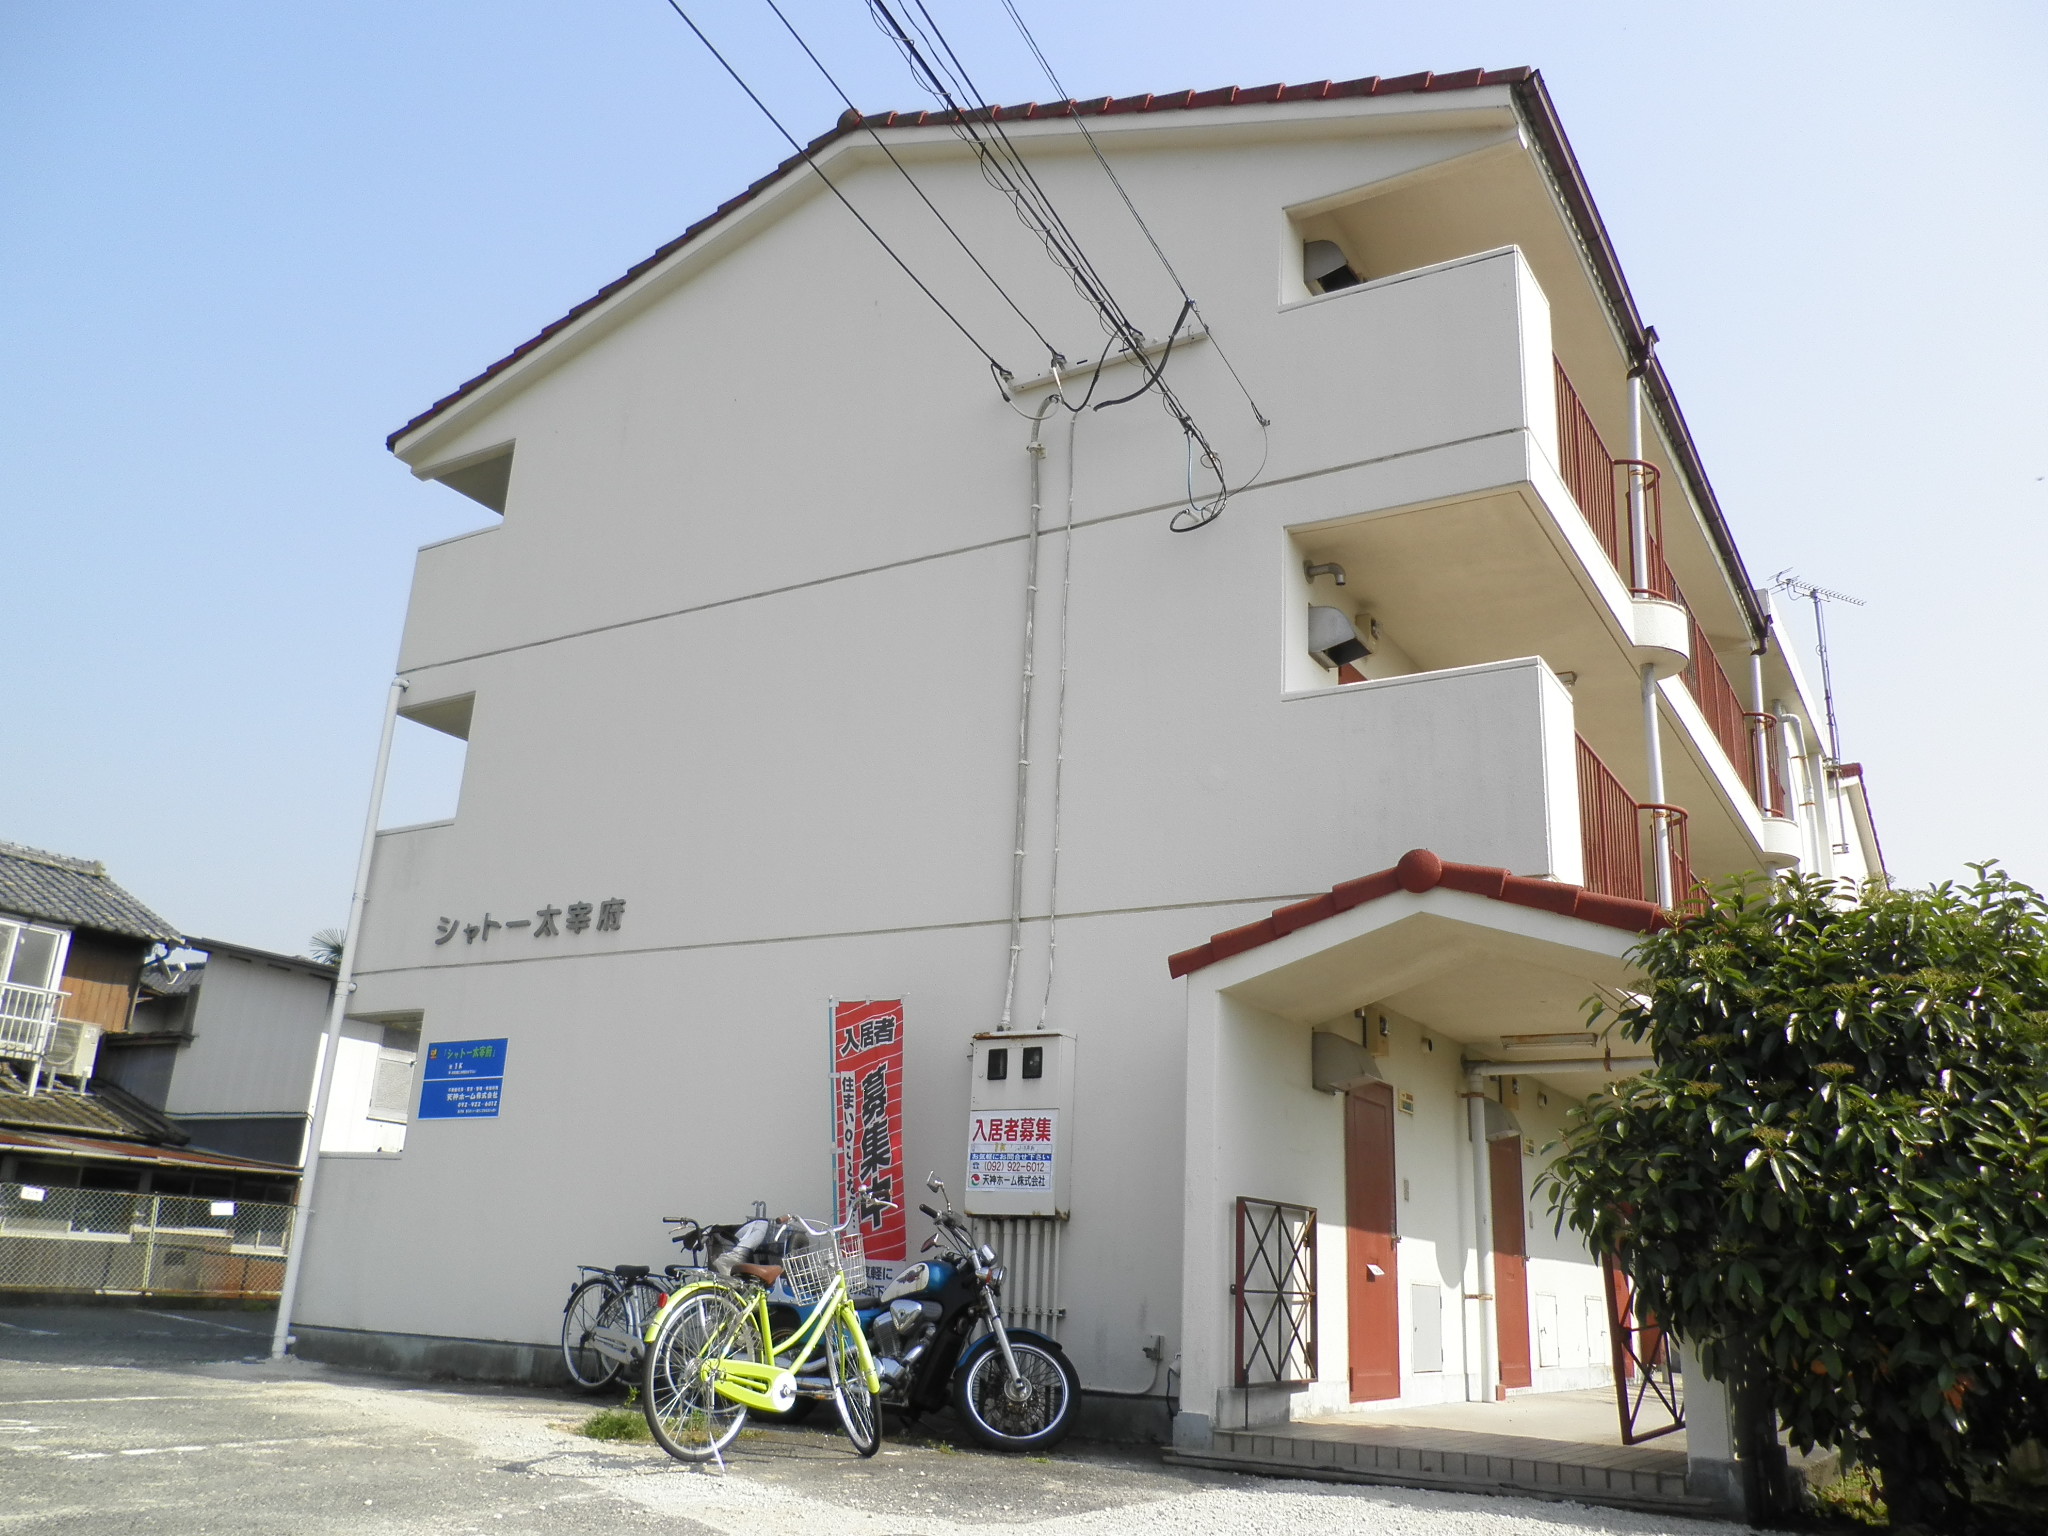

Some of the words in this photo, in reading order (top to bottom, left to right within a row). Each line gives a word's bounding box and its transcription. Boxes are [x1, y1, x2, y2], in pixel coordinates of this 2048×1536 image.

[434, 897, 626, 945] シャトー太宰府
[840, 1015, 896, 1057] 入居者
[860, 1061, 892, 1231] 募集中
[972, 1117, 1051, 1142] 入居者募集
[982, 1174, 1046, 1187] 天神ホーム株式会社
